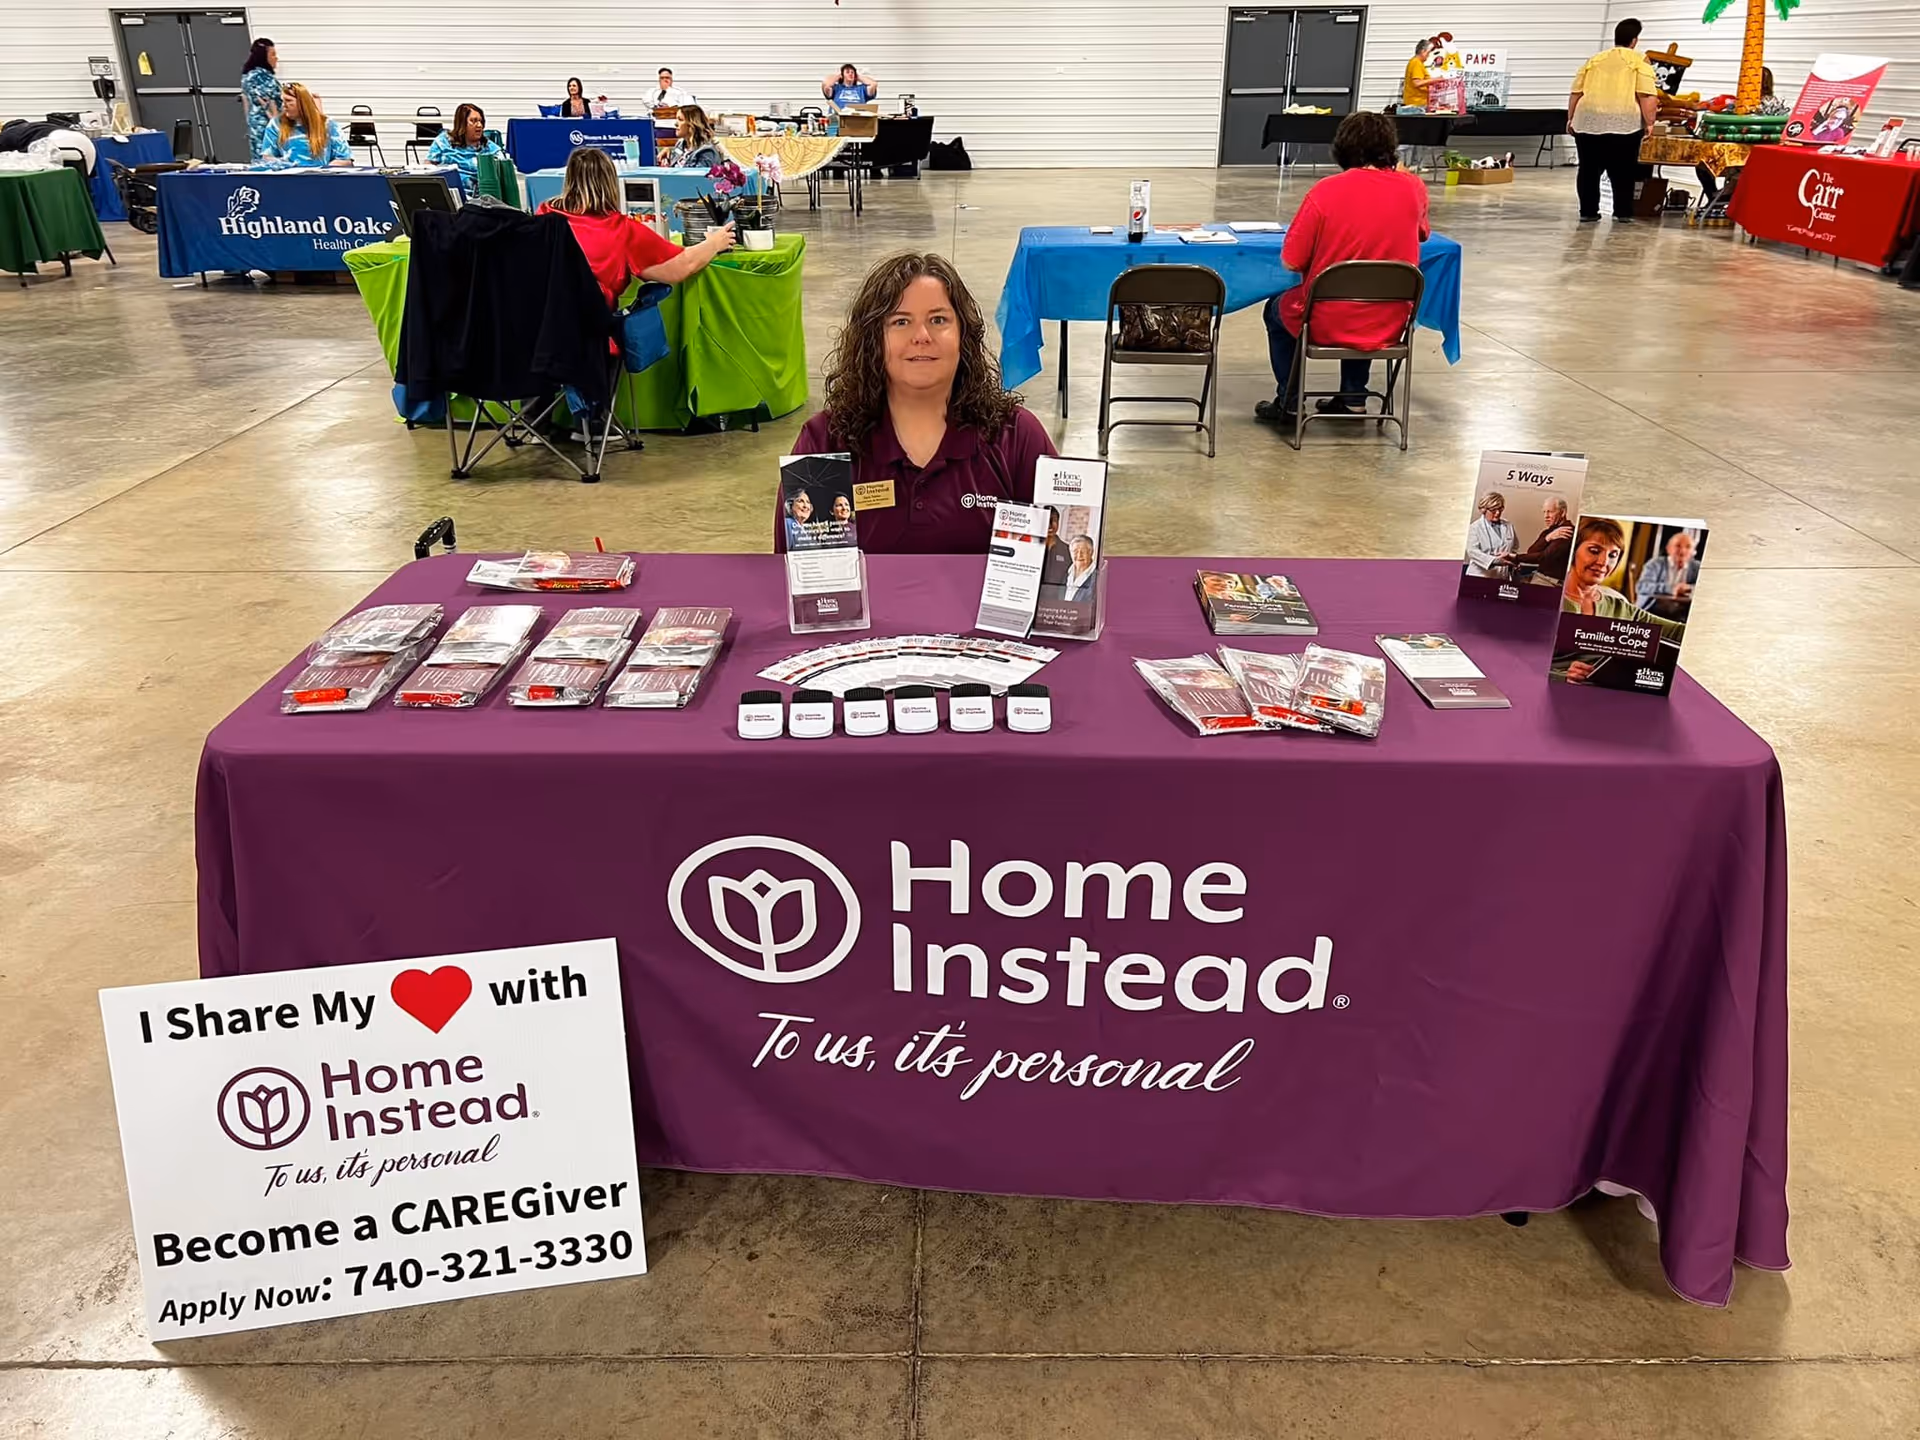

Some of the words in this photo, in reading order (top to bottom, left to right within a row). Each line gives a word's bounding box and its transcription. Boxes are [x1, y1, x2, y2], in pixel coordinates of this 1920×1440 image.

[1465, 54, 1496, 65] PAWS
[1798, 168, 1844, 228] Carr
[218, 216, 328, 239] Highland
[333, 216, 393, 235] Oaks
[313, 238, 351, 250] Health
[976, 493, 998, 502] Home
[1506, 470, 1515, 480] 5
[1518, 471, 1554, 486] Ways
[1574, 629, 1615, 643] Families
[1618, 635, 1649, 649] Cope
[1610, 621, 1652, 639] Helping
[891, 839, 1247, 924] Home
[139, 1010, 153, 1044] I
[166, 1003, 300, 1041] Share
[312, 990, 376, 1031] My
[488, 965, 588, 1006] with
[320, 1055, 485, 1099] Home
[752, 1012, 815, 1068] To
[814, 1032, 876, 1072] us,
[895, 1020, 974, 1078] it's
[959, 1038, 1255, 1101] personal
[264, 1163, 294, 1197] To
[295, 1166, 328, 1185] us,
[336, 1148, 374, 1181] it's
[370, 1133, 501, 1188] personal
[153, 1223, 340, 1267] Become
[353, 1214, 378, 1242] a
[391, 1181, 628, 1235] CAREGiver
[158, 1290, 247, 1327] Apply
[254, 1276, 332, 1311] Now:
[344, 1230, 633, 1297] 740-321-3330
